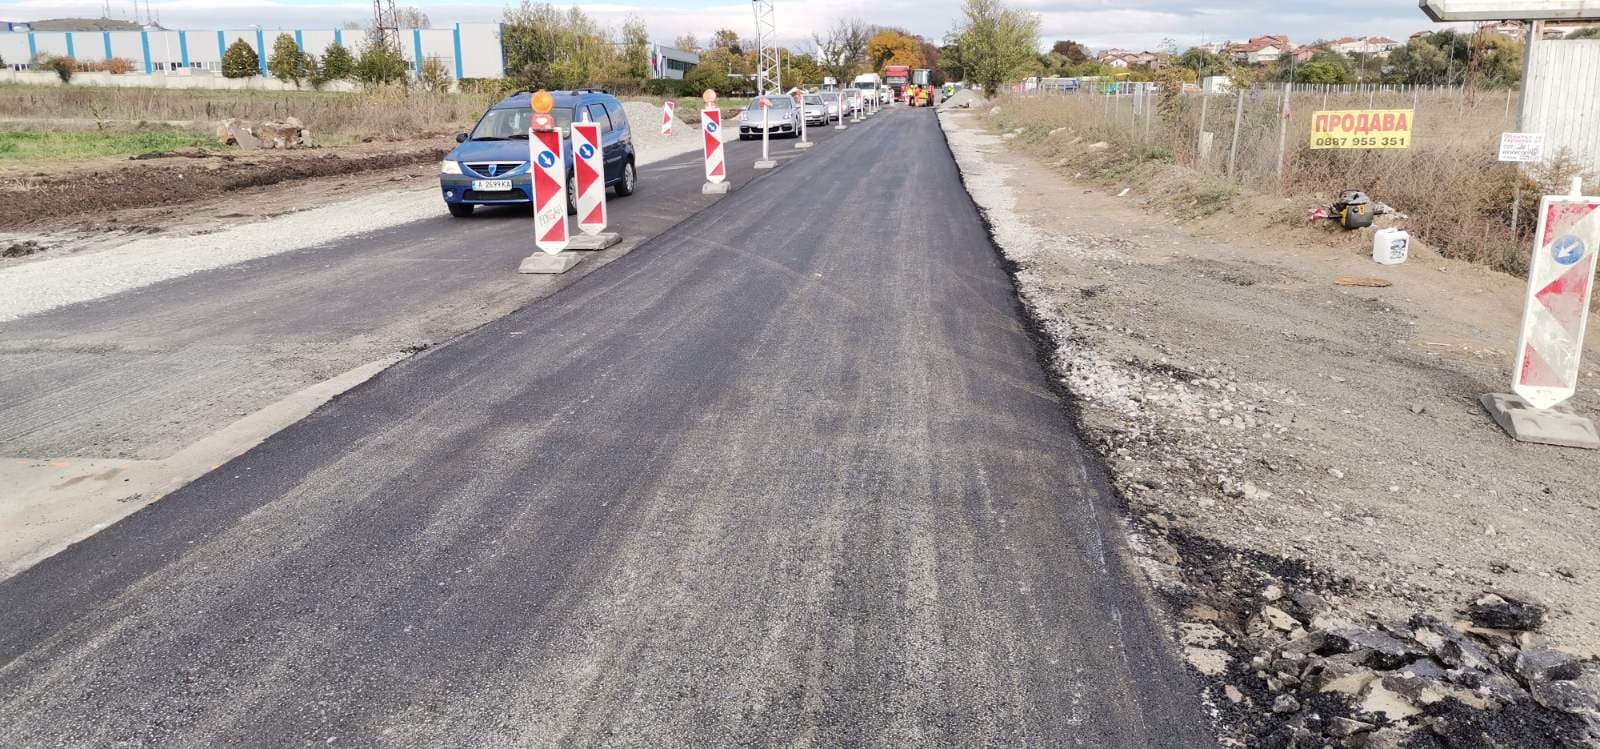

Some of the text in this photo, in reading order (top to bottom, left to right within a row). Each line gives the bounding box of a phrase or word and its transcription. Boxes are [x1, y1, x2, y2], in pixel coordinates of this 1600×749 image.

[1315, 113, 1408, 135] ПРОДАВА
[1316, 137, 1405, 146] 0887 955 351
